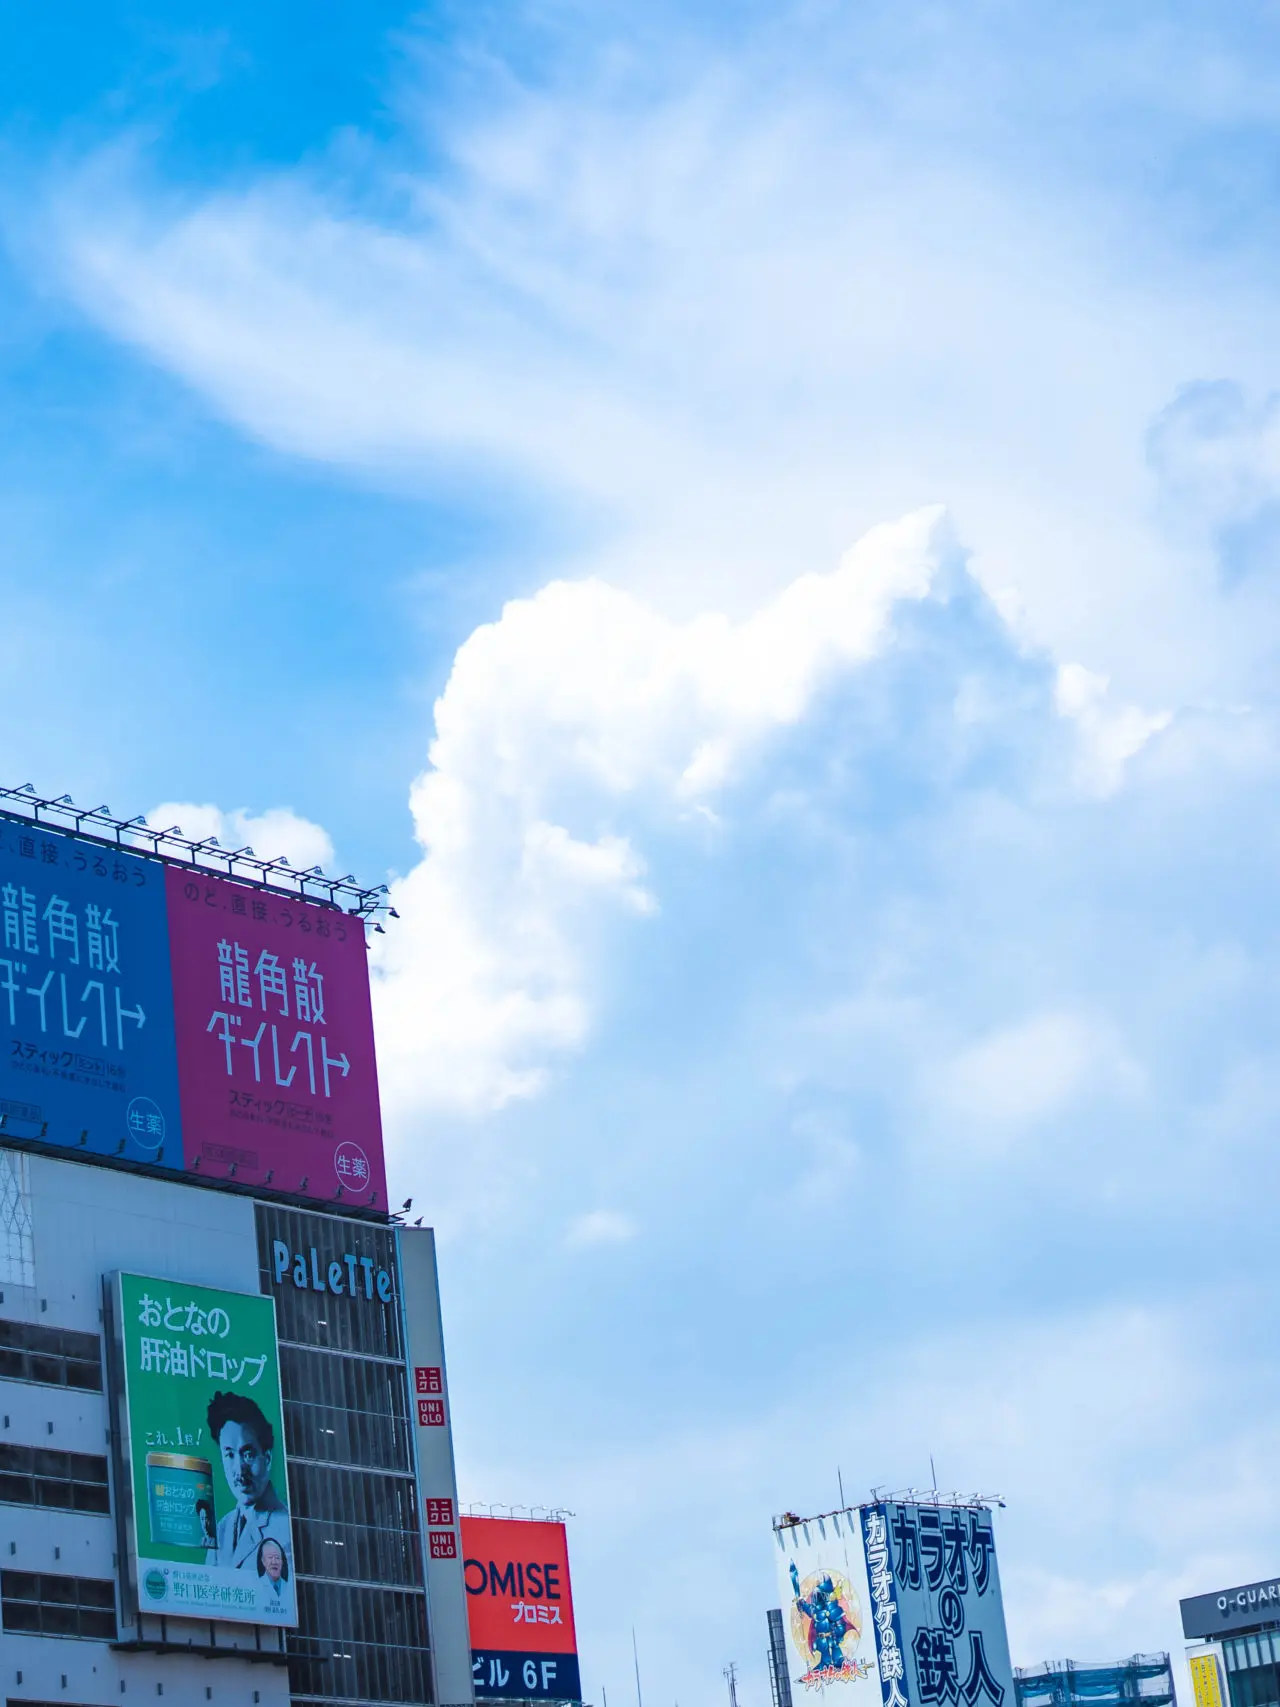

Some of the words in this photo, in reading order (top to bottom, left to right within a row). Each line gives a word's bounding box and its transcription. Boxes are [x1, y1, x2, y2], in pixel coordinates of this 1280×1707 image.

[0, 882, 122, 974] 龍角散
[217, 938, 328, 1026] 龍角散
[206, 1010, 351, 1098] ダイレクト
[130, 1110, 162, 1135] 生薬
[337, 1155, 368, 1179] 生薬
[138, 1293, 230, 1338] おとなの
[140, 1336, 267, 1386] 肝油ドロップ
[421, 1403, 439, 1412] UNI
[422, 1414, 442, 1424] QLO
[432, 1535, 451, 1545] UNI
[433, 1546, 454, 1557] QLO
[891, 1503, 995, 1597] カラオケ
[173, 1582, 256, 1605] 野口医学研究所
[463, 1559, 561, 1599] OMISE
[510, 1601, 563, 1624] プロミス
[865, 1512, 908, 1707] カラオケの鉄人
[939, 1586, 965, 1638] の
[1217, 1584, 1280, 1610] O-GUAR
[522, 1660, 557, 1689] 6F
[912, 1627, 1005, 1707] 鉄人
